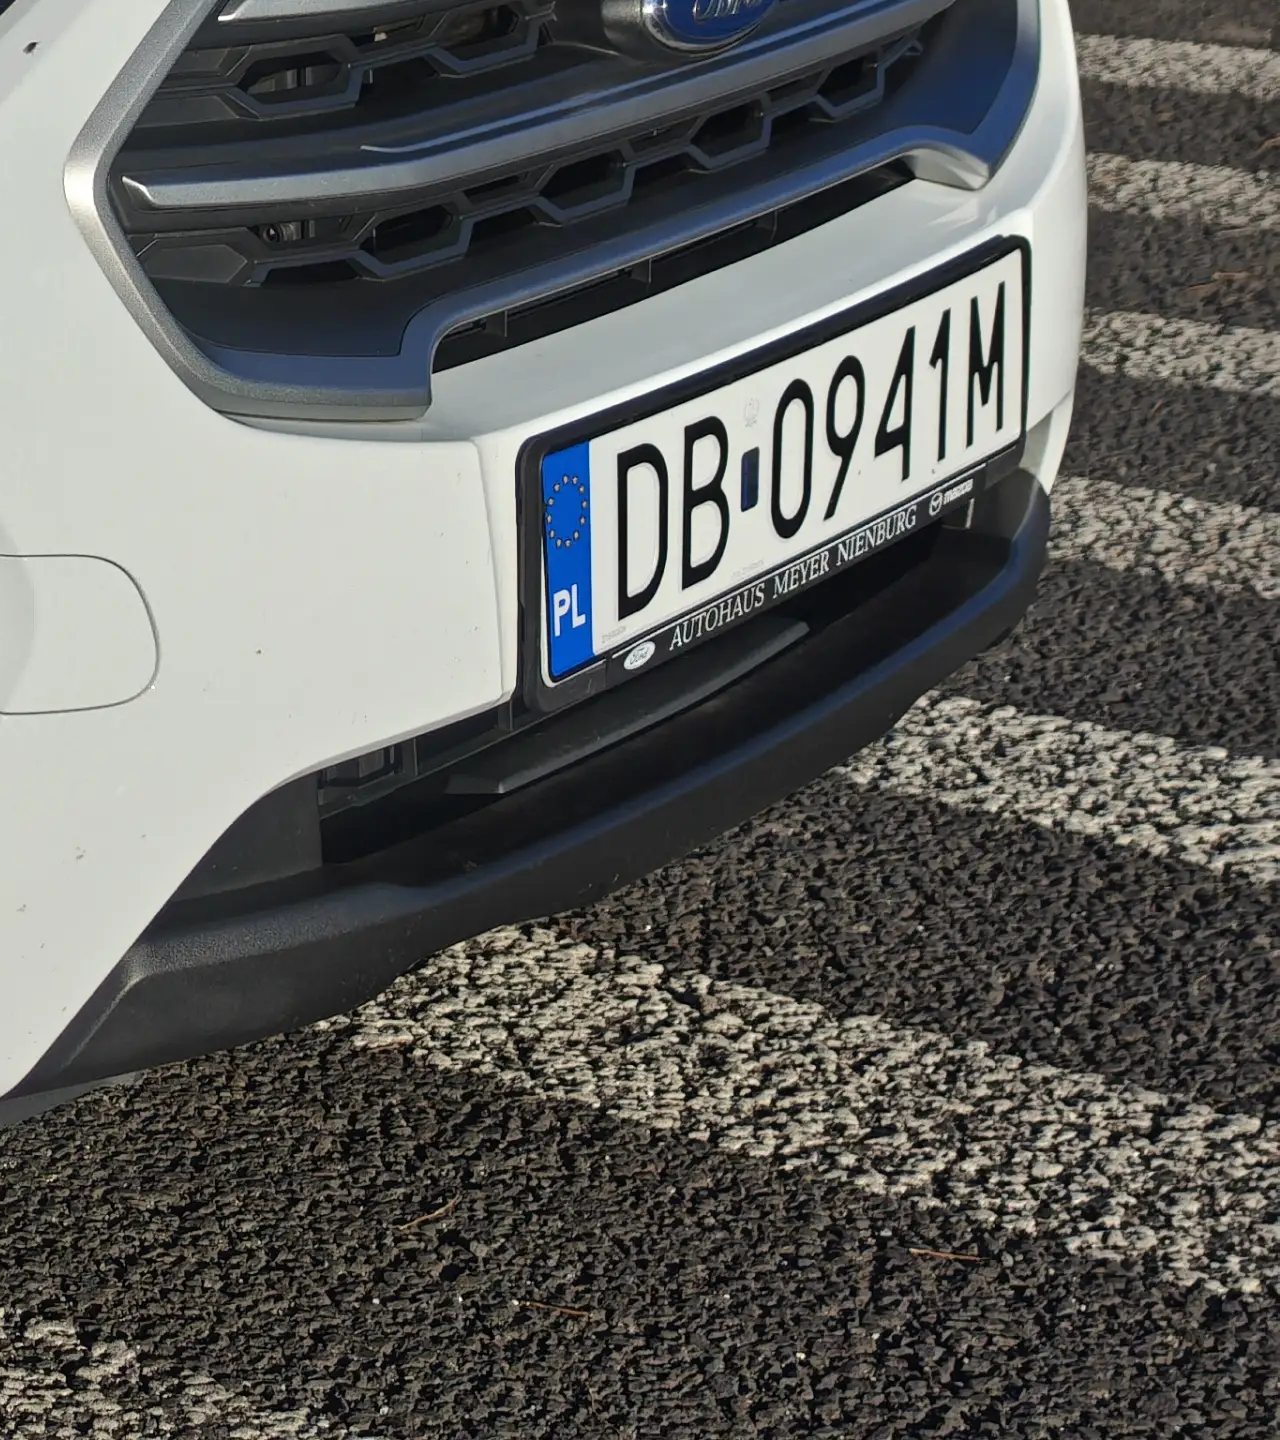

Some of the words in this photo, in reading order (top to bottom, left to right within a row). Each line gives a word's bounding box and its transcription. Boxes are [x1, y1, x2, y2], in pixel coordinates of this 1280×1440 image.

[616, 415, 731, 623] DB
[770, 281, 1007, 540] 0941M
[552, 583, 587, 638] PL
[669, 583, 767, 651] AUTOHAUS
[773, 552, 830, 600] MEYER
[836, 505, 918, 567] NIENBURG
